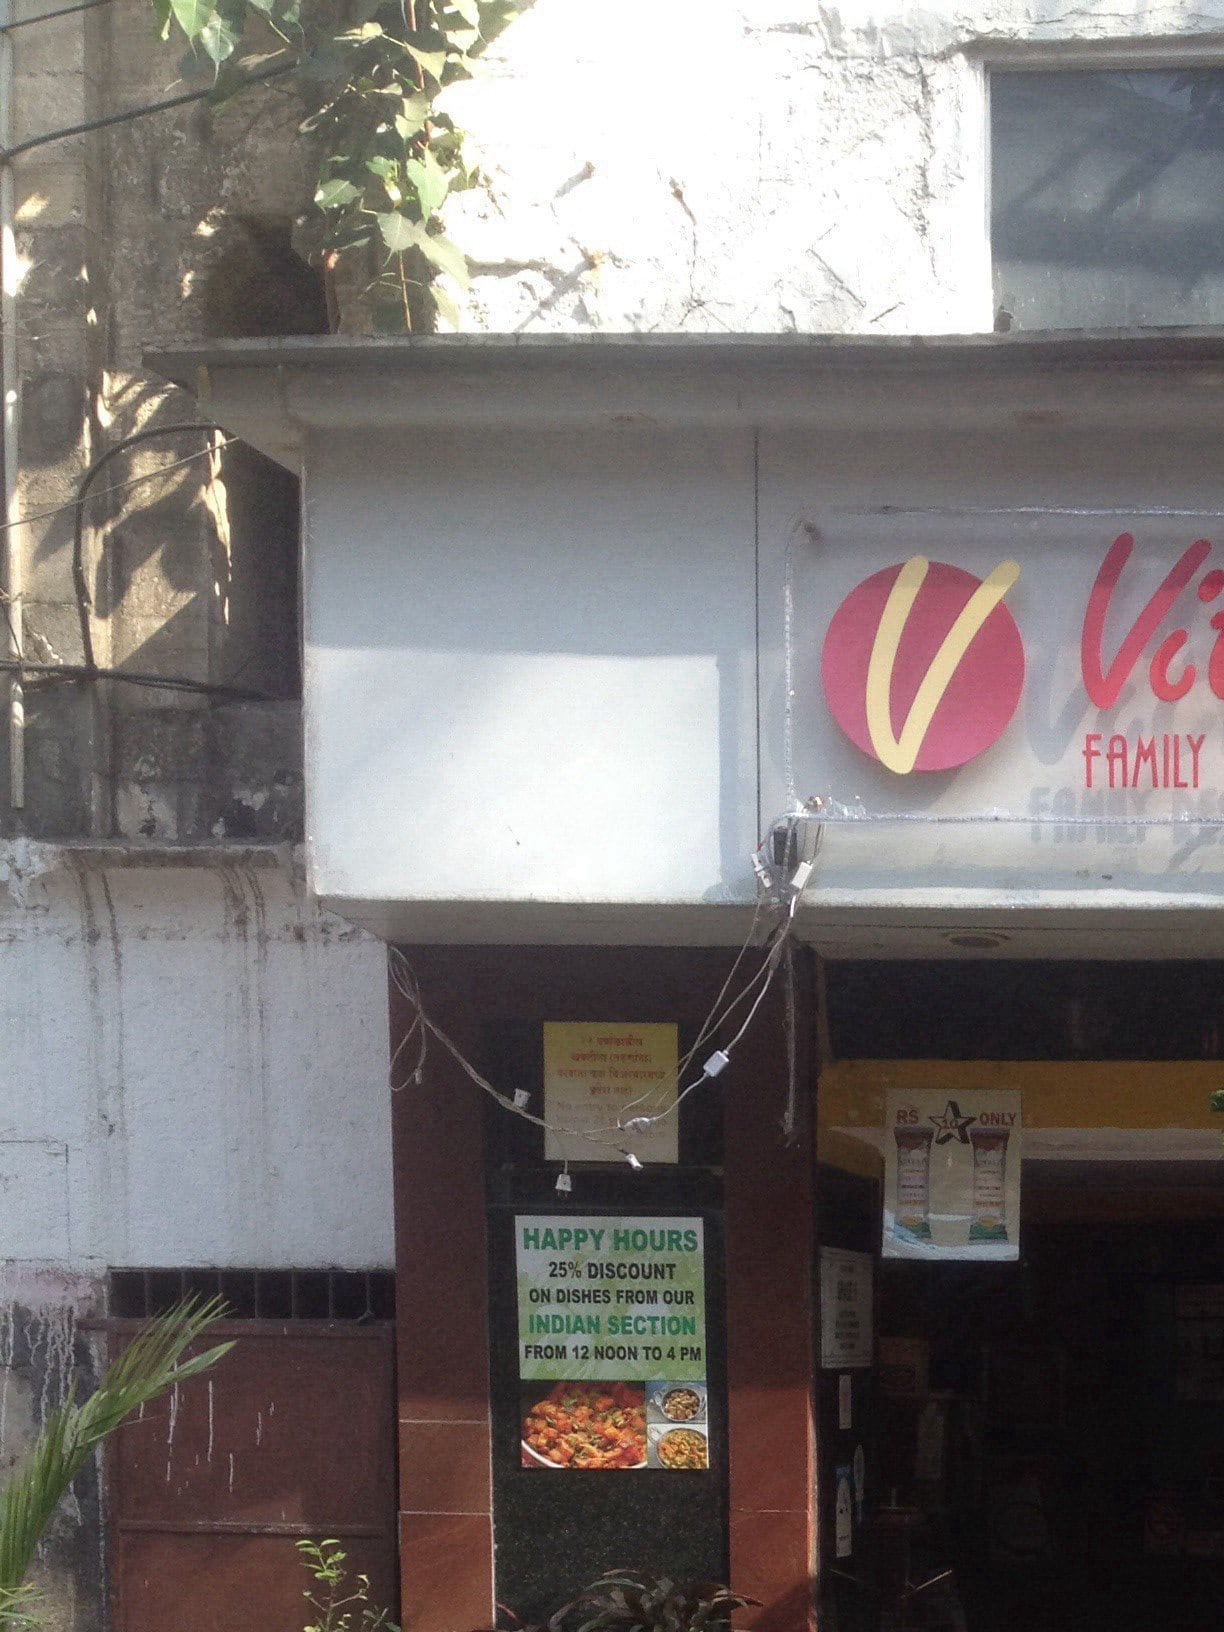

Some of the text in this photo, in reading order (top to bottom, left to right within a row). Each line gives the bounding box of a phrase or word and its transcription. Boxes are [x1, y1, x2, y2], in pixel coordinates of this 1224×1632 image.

[1082, 733, 1205, 788] FAMILY
[979, 1112, 1017, 1126] ONLY
[523, 1227, 698, 1252] HAPPY HOURS
[548, 1261, 676, 1280] 25% DISCOUNT
[529, 1288, 695, 1305] ON DISHES FROM OUR
[528, 1314, 696, 1336] INDIAN SECTION
[524, 1345, 702, 1361] FROM 12 NOON TO 4 PM
